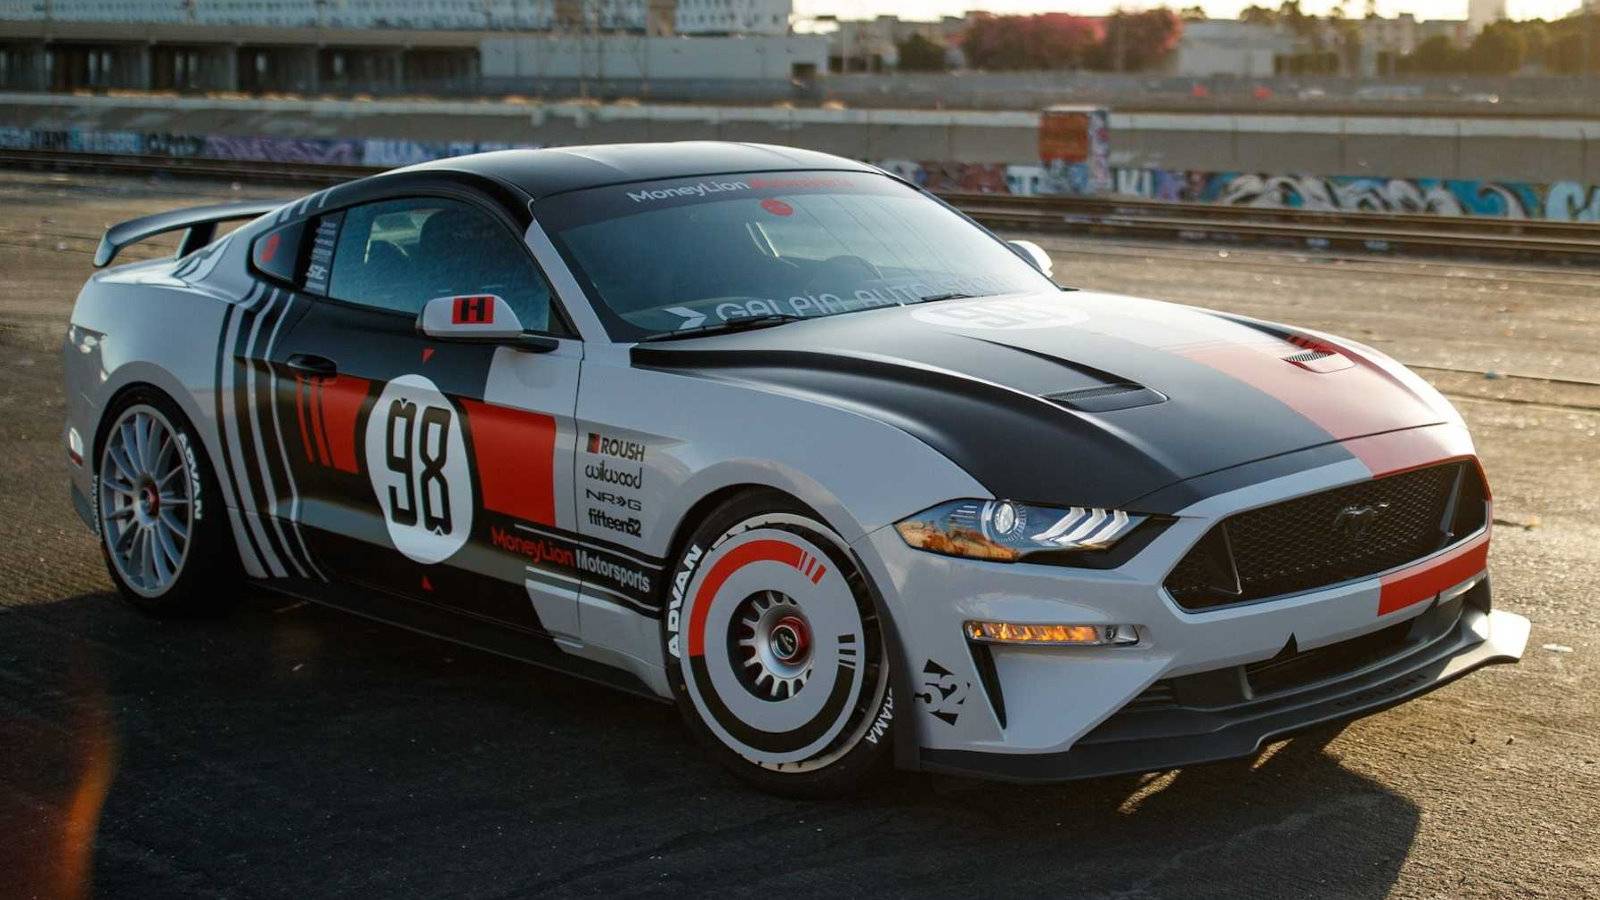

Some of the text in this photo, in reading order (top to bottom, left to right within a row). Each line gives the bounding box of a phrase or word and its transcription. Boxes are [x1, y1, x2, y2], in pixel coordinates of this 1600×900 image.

[627, 178, 750, 203] MoneyLion
[461, 298, 485, 321] H
[601, 437, 645, 462] ROUSH
[177, 433, 202, 520] ADVAN
[386, 397, 453, 536] 98
[585, 460, 642, 490] wilwood
[588, 507, 642, 538] fifteen52
[491, 527, 650, 593] MoneyLion Motorsports
[668, 544, 703, 658] ADVAN
